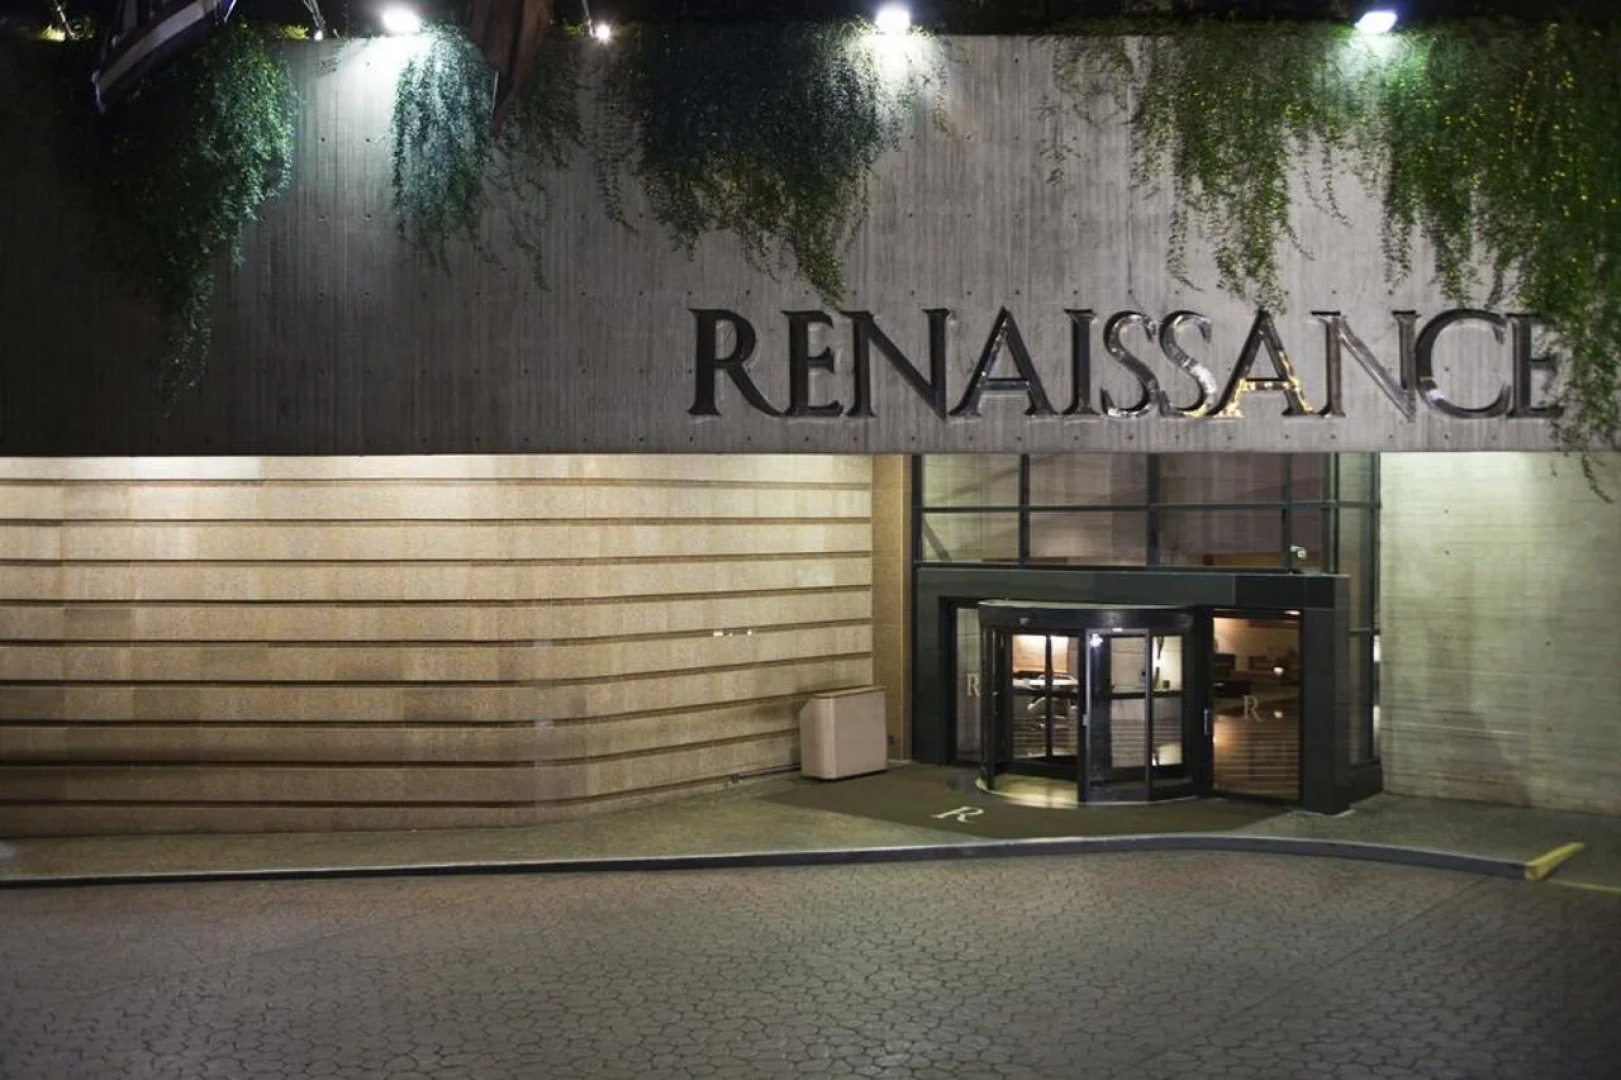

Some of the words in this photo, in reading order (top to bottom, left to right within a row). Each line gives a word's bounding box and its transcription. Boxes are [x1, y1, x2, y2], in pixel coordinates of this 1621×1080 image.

[688, 306, 1564, 420] RENAISSANCE
[966, 673, 981, 696] R
[1242, 694, 1262, 722] R
[931, 805, 985, 823] R
